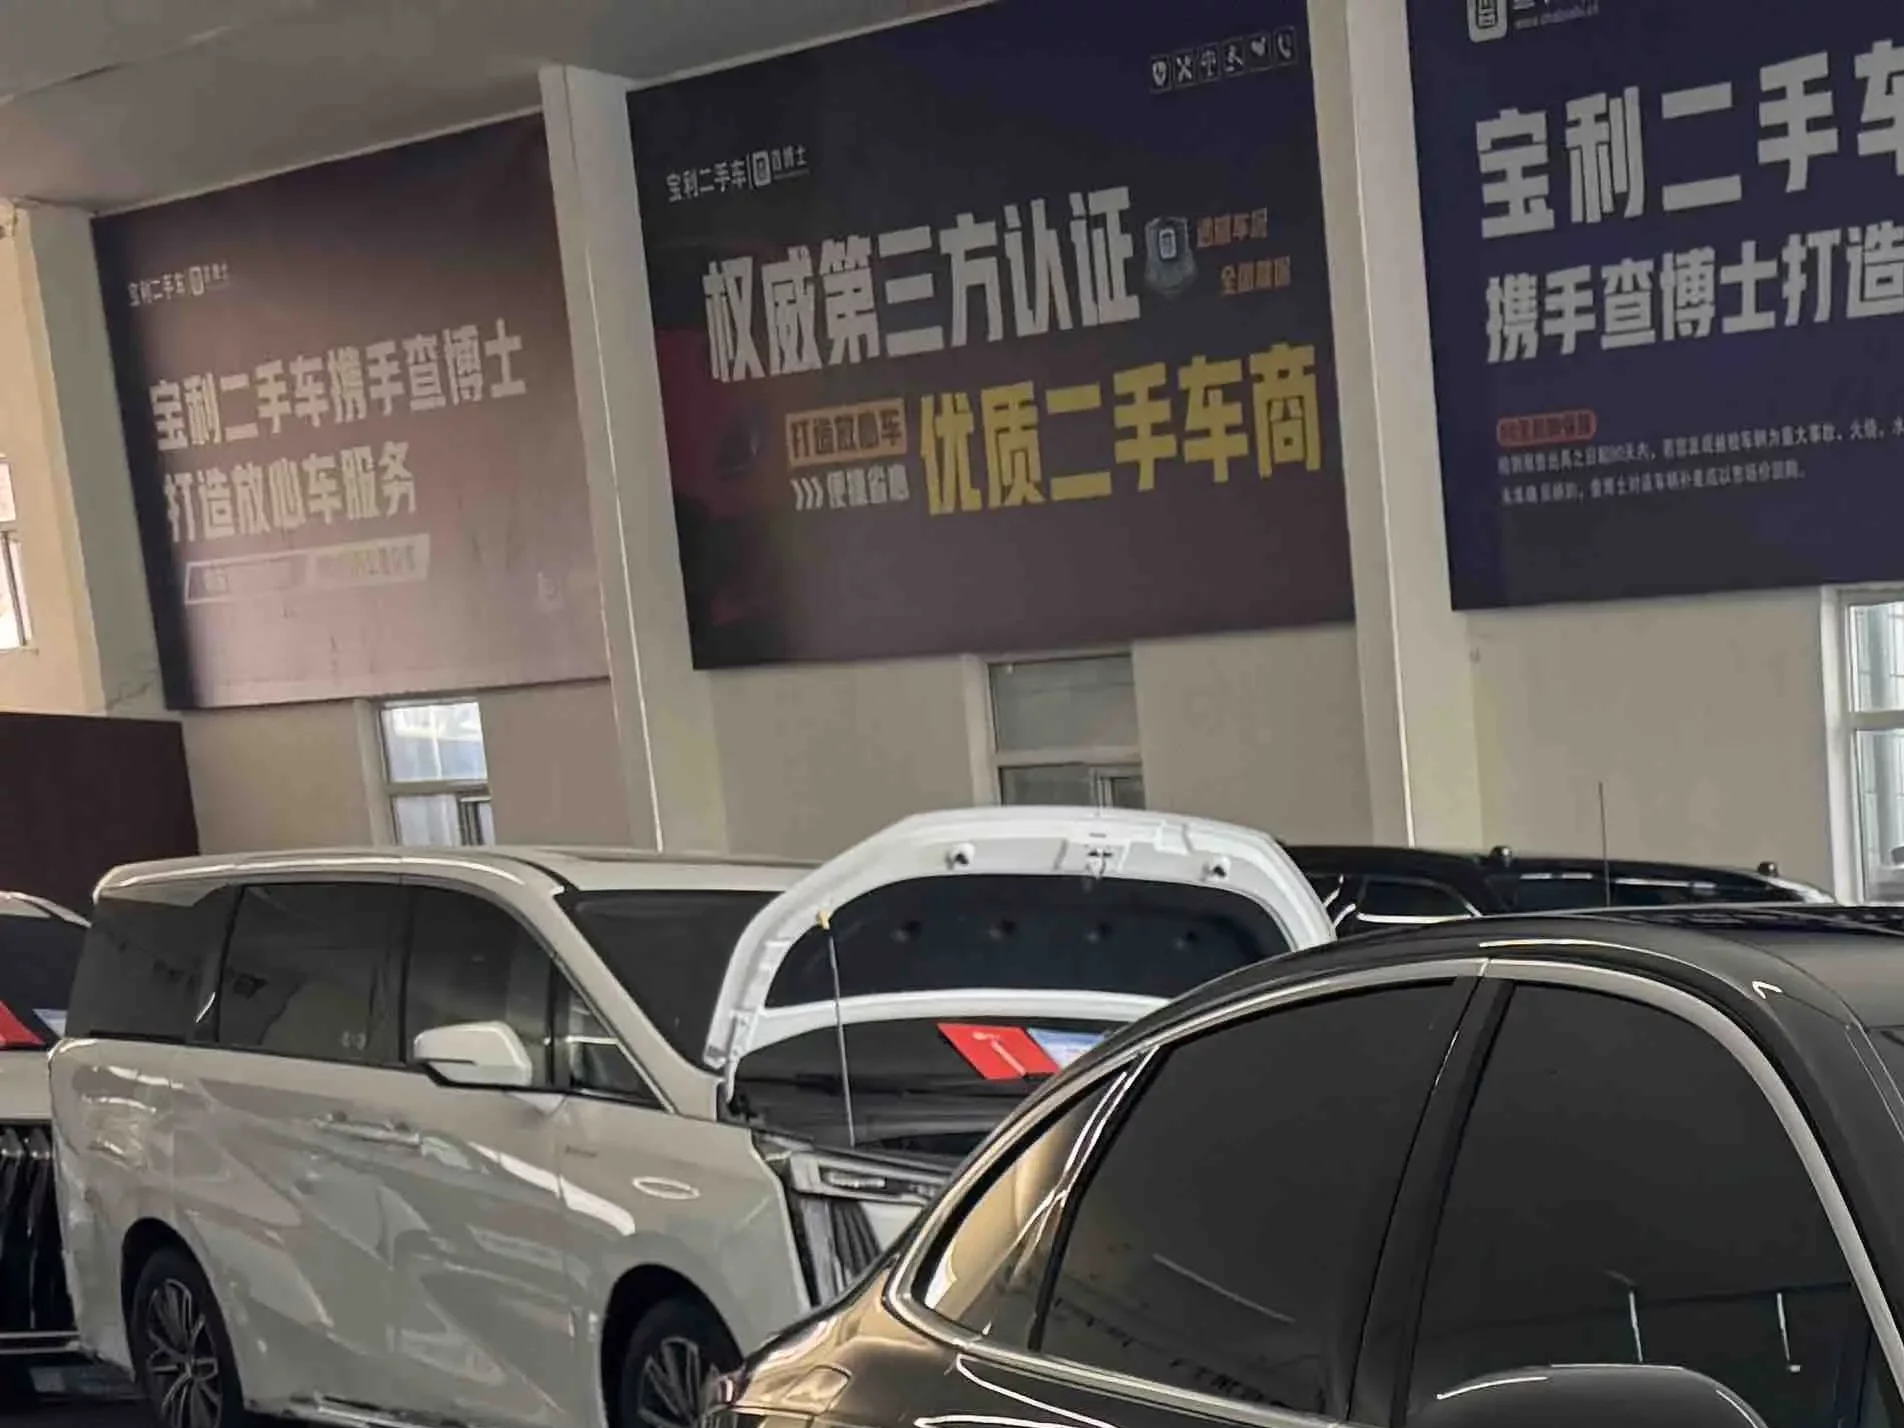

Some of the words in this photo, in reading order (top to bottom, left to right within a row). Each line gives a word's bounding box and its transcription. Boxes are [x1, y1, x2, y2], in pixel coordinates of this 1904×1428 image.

[666, 159, 747, 202] 宝利二手车
[702, 187, 1141, 383] 权威第三方认证
[149, 317, 527, 451] 宝利二手车携手查博士
[920, 342, 1321, 516] 优质二手车商
[164, 441, 416, 544] 打造放心车服务
